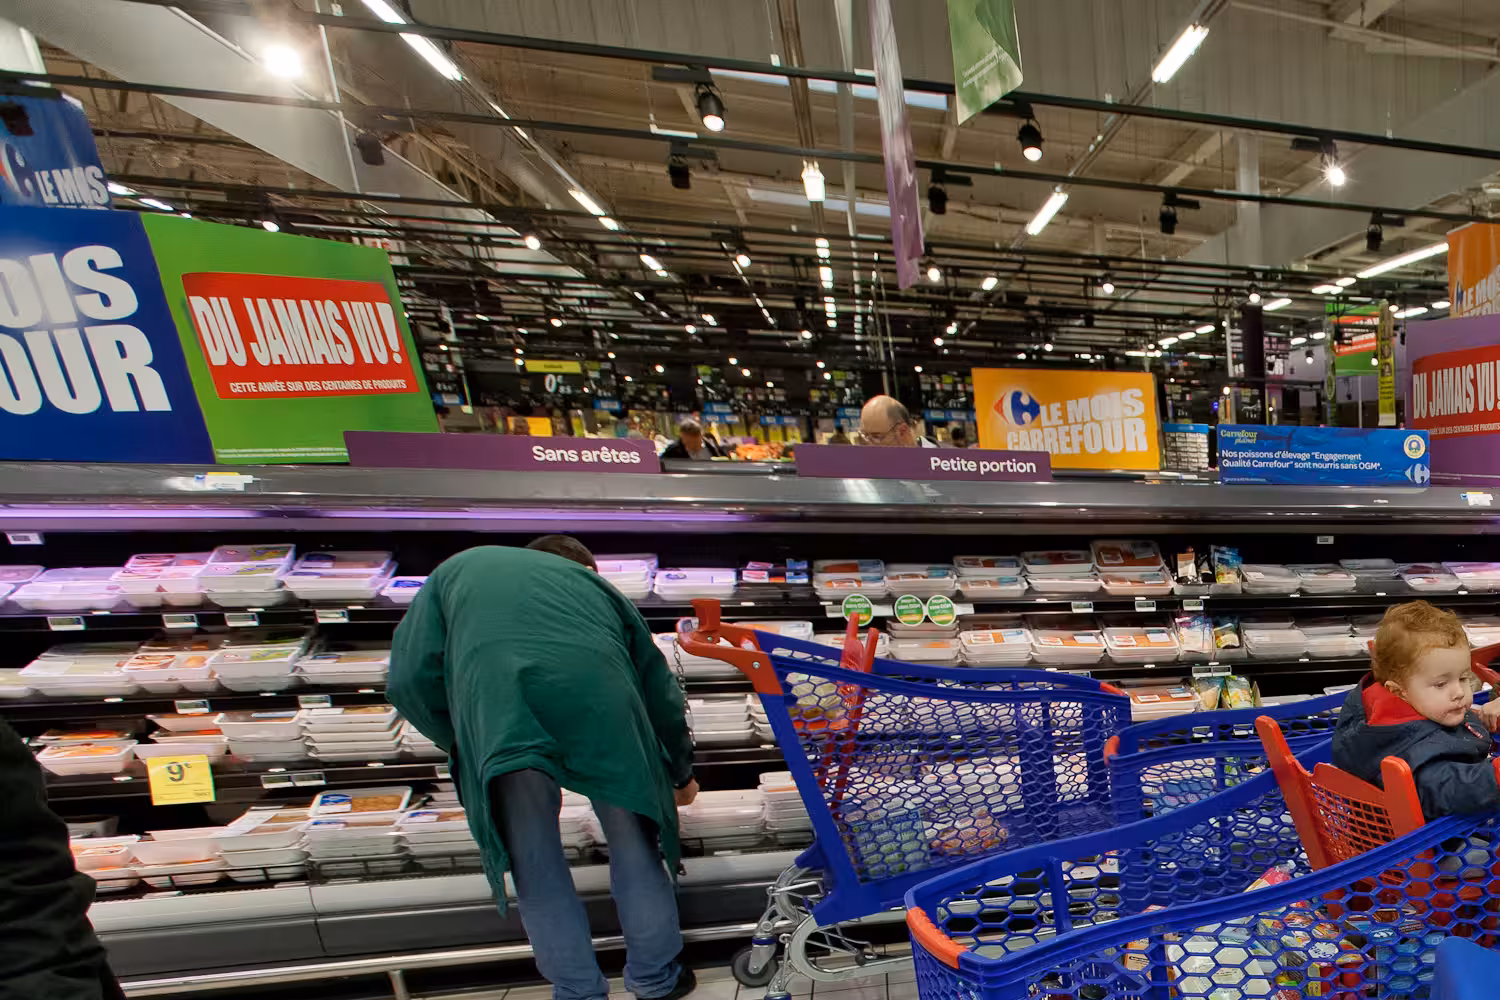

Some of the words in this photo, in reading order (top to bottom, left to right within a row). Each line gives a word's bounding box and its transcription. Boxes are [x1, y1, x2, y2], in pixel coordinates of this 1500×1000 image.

[35, 169, 58, 204] LE
[188, 295, 248, 367] DU
[242, 297, 355, 367] JAMAIS
[229, 382, 257, 393] CETTE
[258, 379, 286, 393] ANNÉE
[288, 381, 304, 392] SUR
[304, 380, 322, 391] DES
[322, 379, 362, 391] CENTAINES
[363, 380, 373, 390] DE
[373, 379, 407, 390] PRODUITS
[1412, 371, 1428, 420] DU
[1429, 364, 1476, 418] JAMAIS
[1040, 404, 1063, 427] LE
[1066, 388, 1146, 424] MOIS
[1007, 417, 1149, 455] CARREFOUR
[1220, 429, 1258, 438] Carrefour
[532, 445, 579, 463] Sans
[581, 445, 641, 464] arêtes
[1222, 449, 1238, 458] Nos
[1238, 449, 1274, 460] poissons
[1274, 450, 1311, 461] d'élevage
[930, 456, 978, 472] Petite
[979, 458, 1037, 475] portion
[1222, 459, 1251, 468] Qualité
[1294, 461, 1312, 469] sont
[1312, 461, 1340, 469] nourris
[1340, 462, 1358, 470] sans
